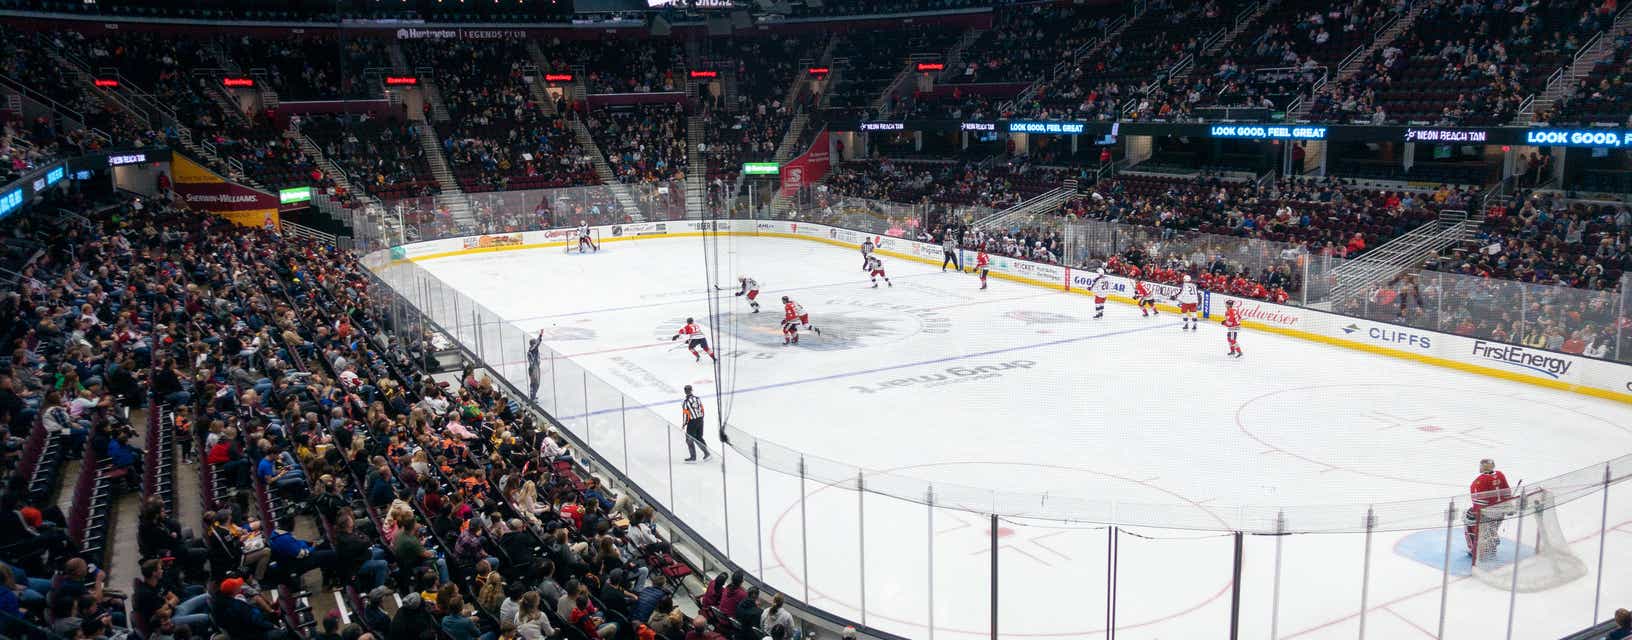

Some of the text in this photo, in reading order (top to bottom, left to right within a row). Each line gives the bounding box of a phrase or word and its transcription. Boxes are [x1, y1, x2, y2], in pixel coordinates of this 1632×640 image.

[1010, 123, 1084, 133] LOOK GOOD, FEEL GREAT
[1211, 126, 1326, 138] LOOK GOOD, FEEL GREAT
[1416, 130, 1486, 141] NEON BEACH TAN
[1528, 131, 1568, 143] LOOK
[1571, 132, 1621, 146] GOOD,
[1189, 286, 1197, 296] 21
[1230, 299, 1299, 325] Budweiser
[1368, 327, 1431, 349] CLIFFS
[1472, 340, 1572, 374] FirstEnergy
